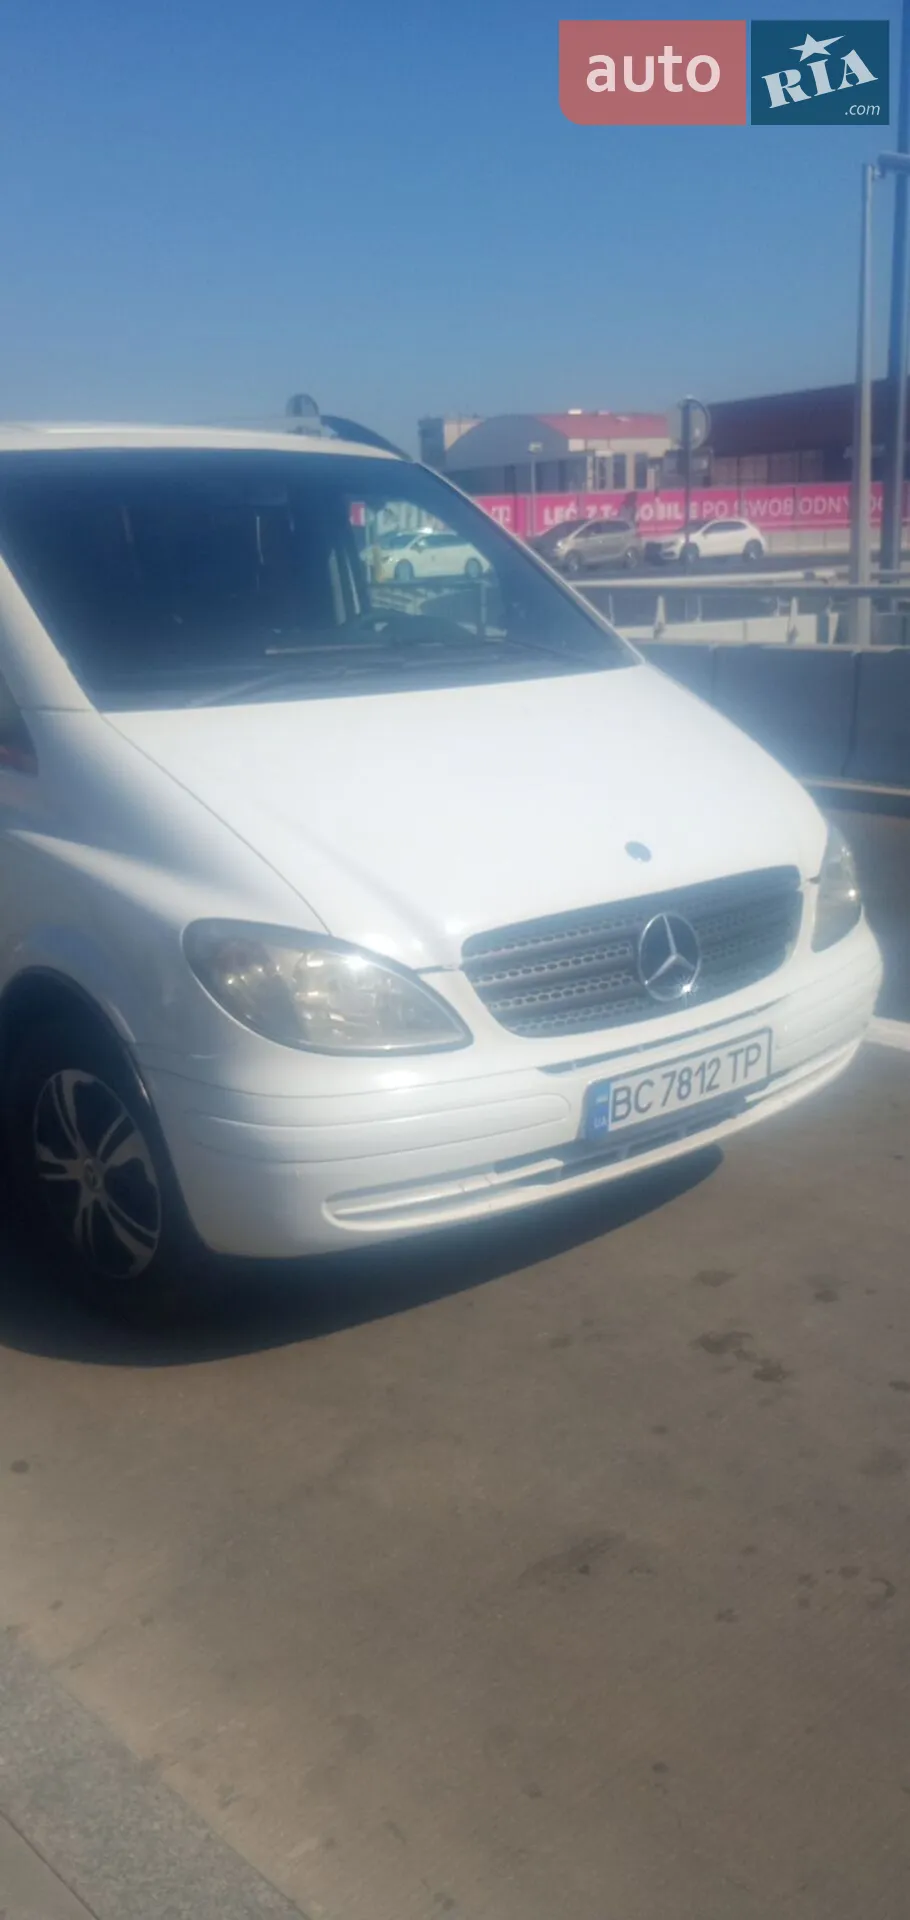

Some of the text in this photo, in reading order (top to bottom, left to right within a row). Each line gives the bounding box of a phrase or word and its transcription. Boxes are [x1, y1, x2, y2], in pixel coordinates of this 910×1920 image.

[600, 497, 698, 521] T-OBILE
[702, 500, 728, 519] PO
[611, 1042, 762, 1122] BC 7812 TP
